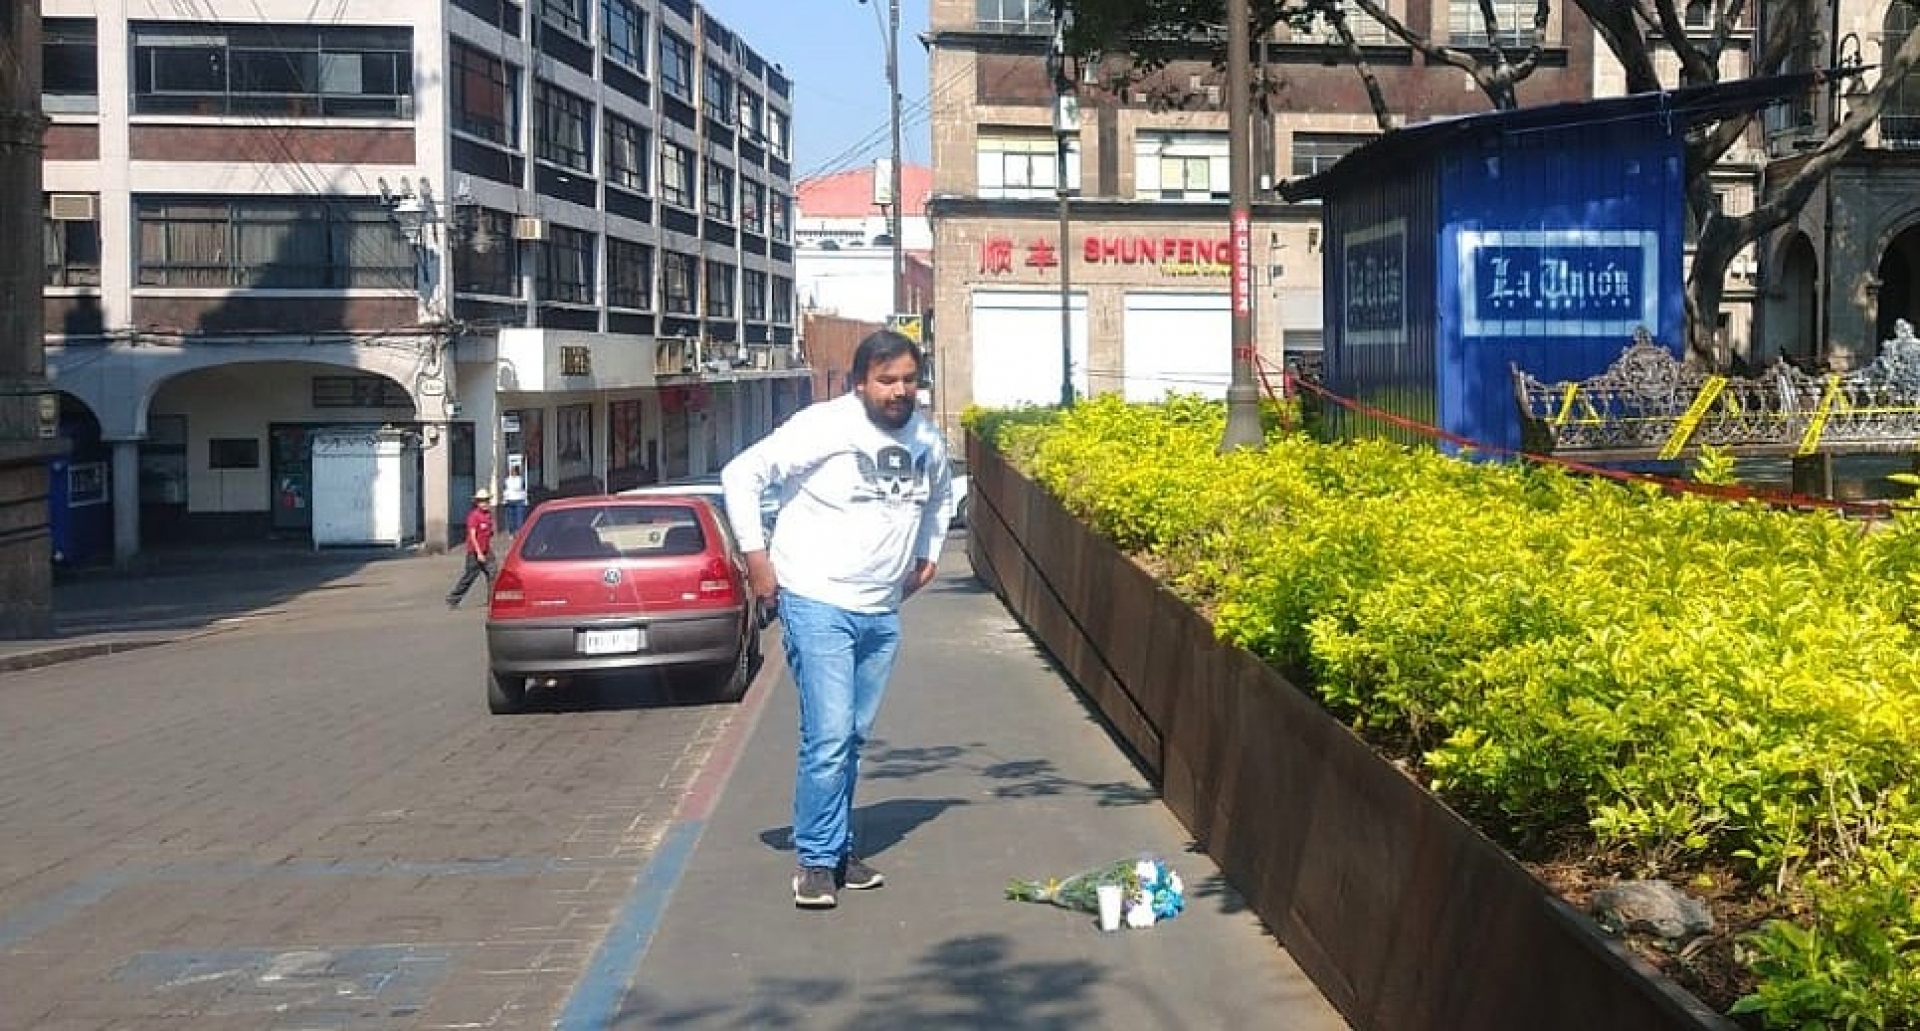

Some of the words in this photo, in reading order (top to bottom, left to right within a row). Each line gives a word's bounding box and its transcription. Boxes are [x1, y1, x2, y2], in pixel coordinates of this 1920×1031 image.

[1083, 236, 1156, 264] SHUN
[1487, 257, 1532, 300] La
[1540, 257, 1630, 300] Unión
